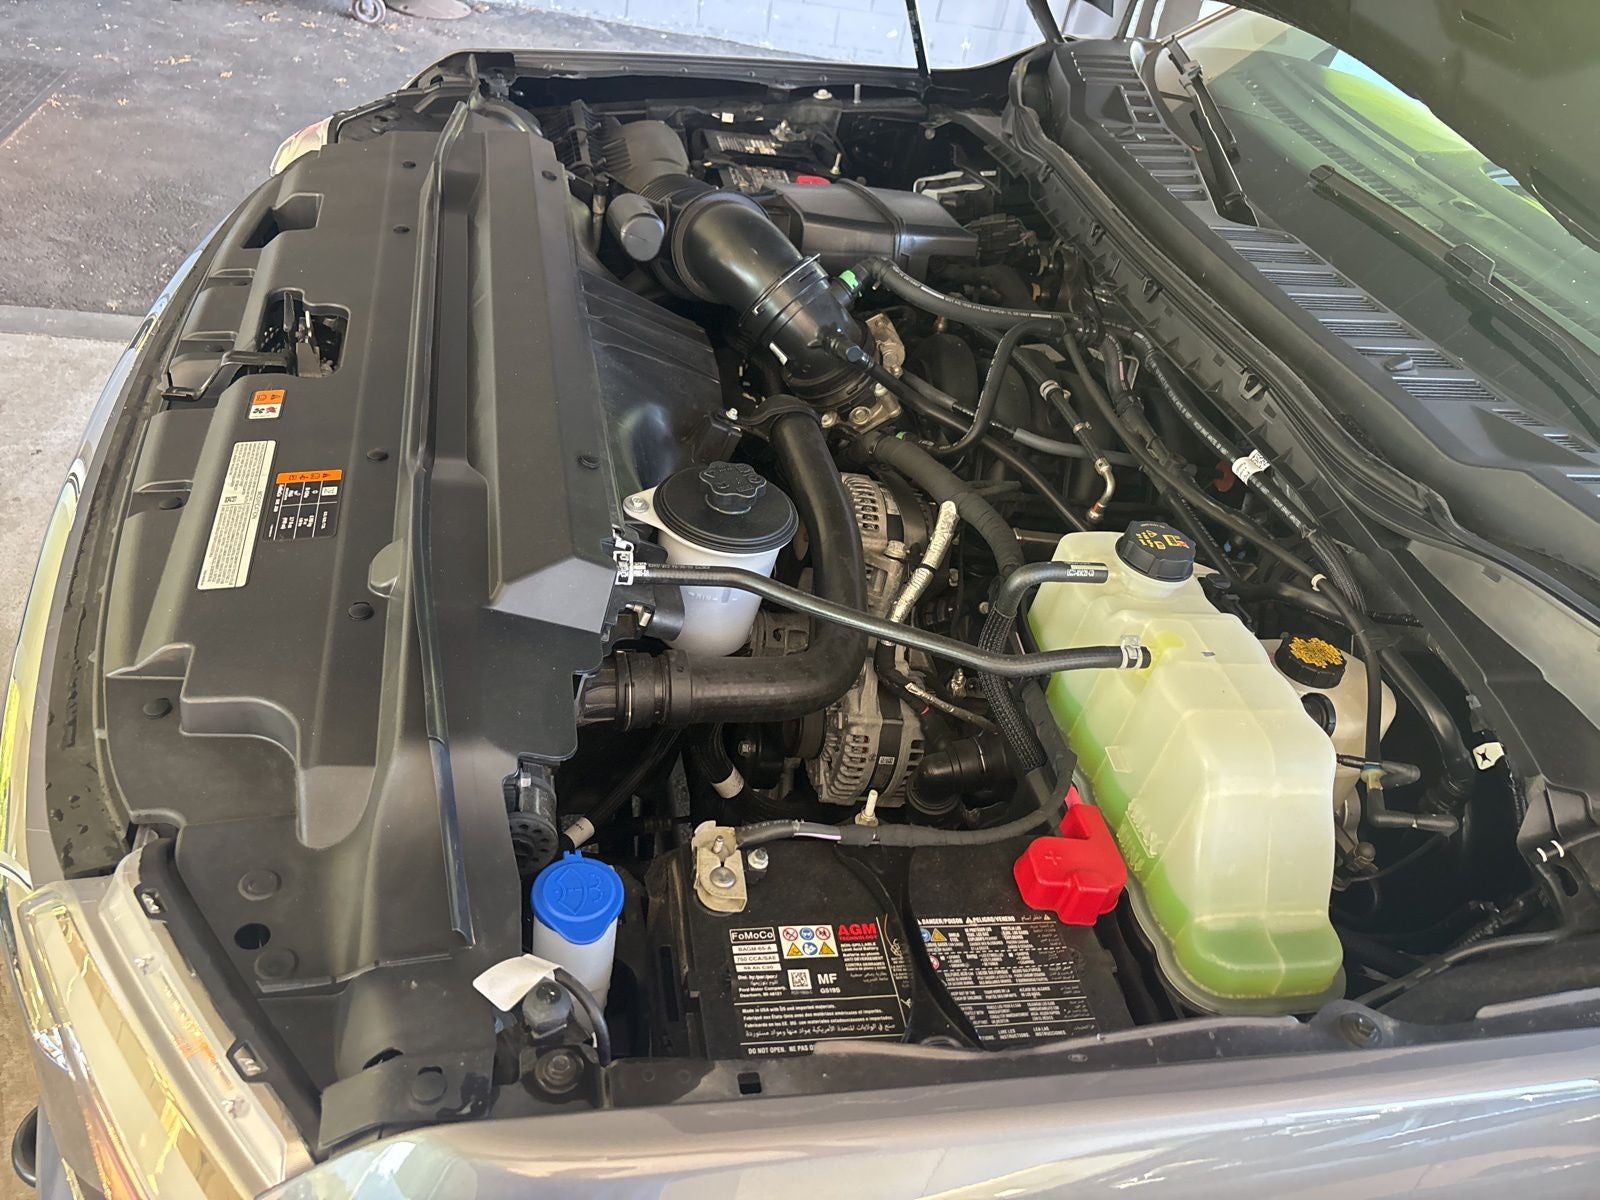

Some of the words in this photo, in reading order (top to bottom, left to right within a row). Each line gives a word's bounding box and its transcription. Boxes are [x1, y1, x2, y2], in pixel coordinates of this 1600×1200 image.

[838, 922, 877, 936] AGM
[731, 930, 773, 940] FoMoCo
[817, 973, 838, 984] MF
[747, 1047, 757, 1055] DO
